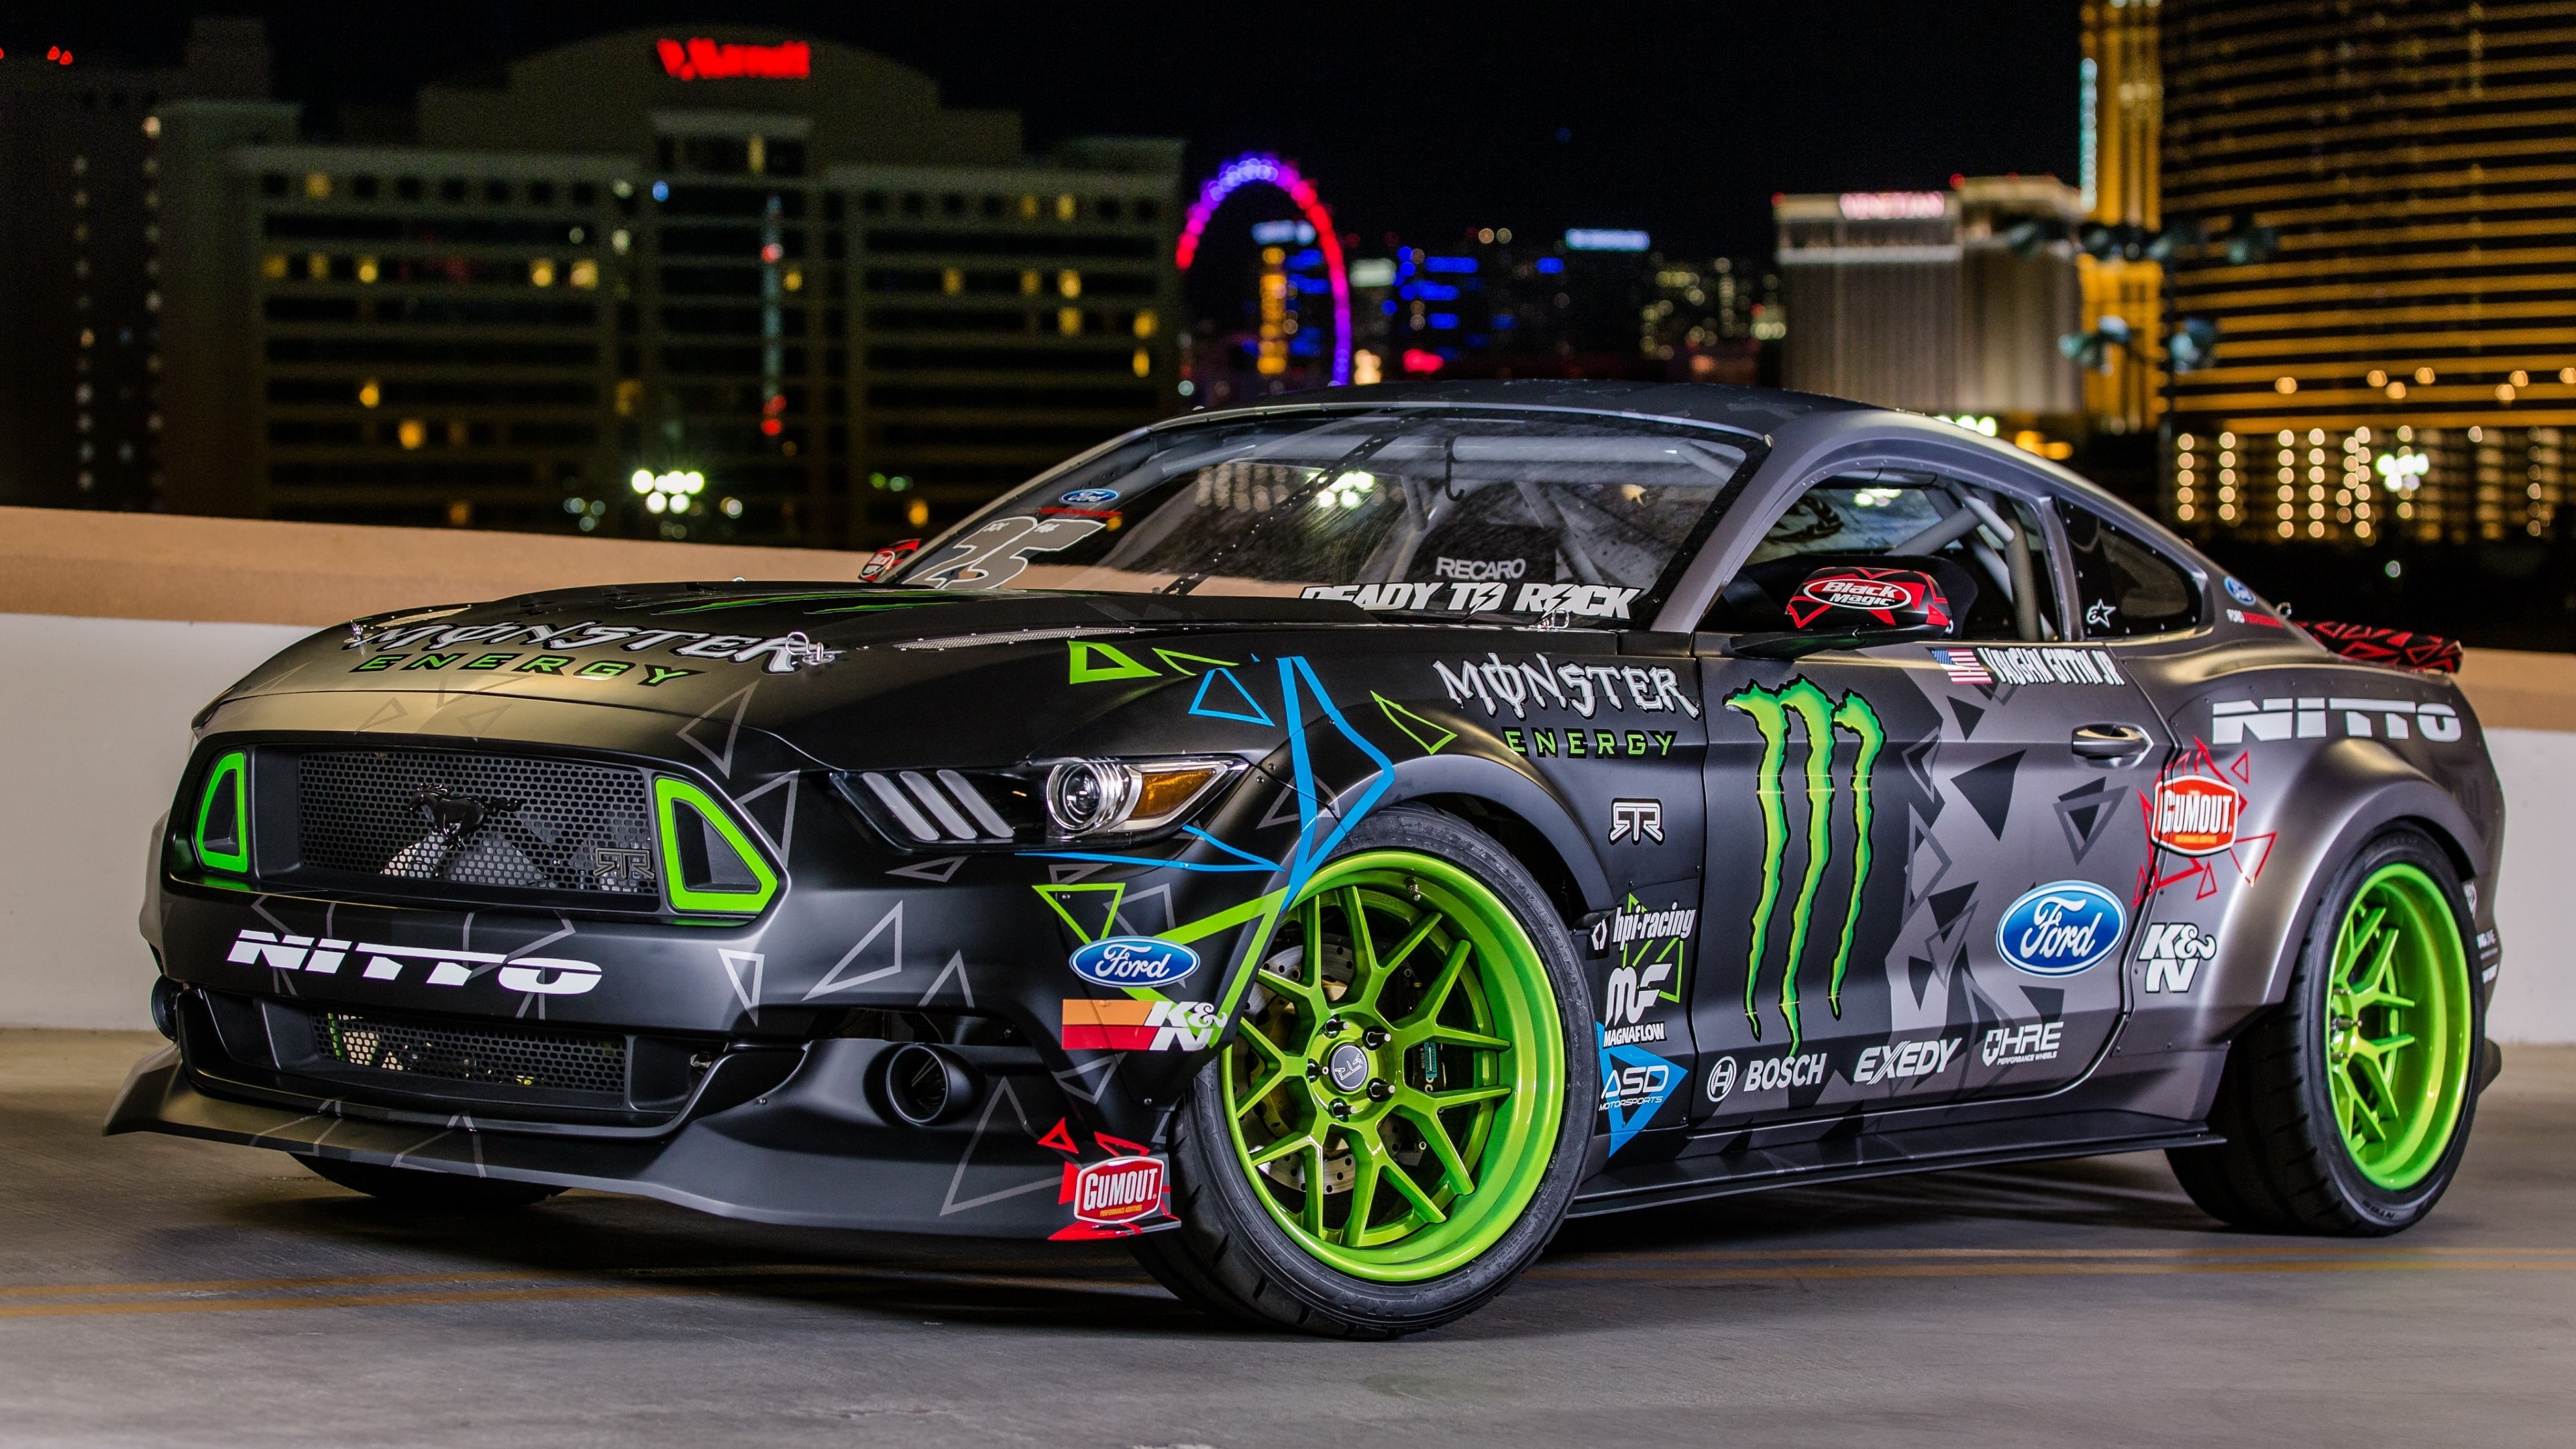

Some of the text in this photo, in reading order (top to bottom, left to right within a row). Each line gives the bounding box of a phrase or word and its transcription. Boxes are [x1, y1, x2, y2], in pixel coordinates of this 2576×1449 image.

[1068, 490, 1109, 502] Ford
[1436, 557, 1526, 580] RECARO
[1448, 582, 1508, 615] TO
[1513, 582, 1642, 619] ROCK
[1821, 582, 1900, 598] Black
[1829, 593, 1891, 606] Magic
[358, 653, 688, 684] ENERGY
[1977, 647, 2055, 686] VAUGHN
[2041, 647, 2104, 684] GITTIN
[2213, 697, 2461, 745] NITTO
[1505, 731, 1673, 756] ENERGY
[2157, 789, 2234, 835] GUMOUT
[2019, 896, 2104, 959] Ford
[227, 929, 602, 995] NITTO
[1095, 943, 1173, 978] Ford
[1603, 1022, 1665, 1048] MAGNAFLOW
[1999, 1021, 2064, 1057] HRE
[1743, 1053, 1827, 1092] BOSCH
[1854, 1037, 1962, 1085] EXEDY
[1601, 1065, 1669, 1100] ASD
[1599, 1095, 1664, 1112] MOTORSPORTS
[1083, 1167, 1159, 1211] GUMOUT
